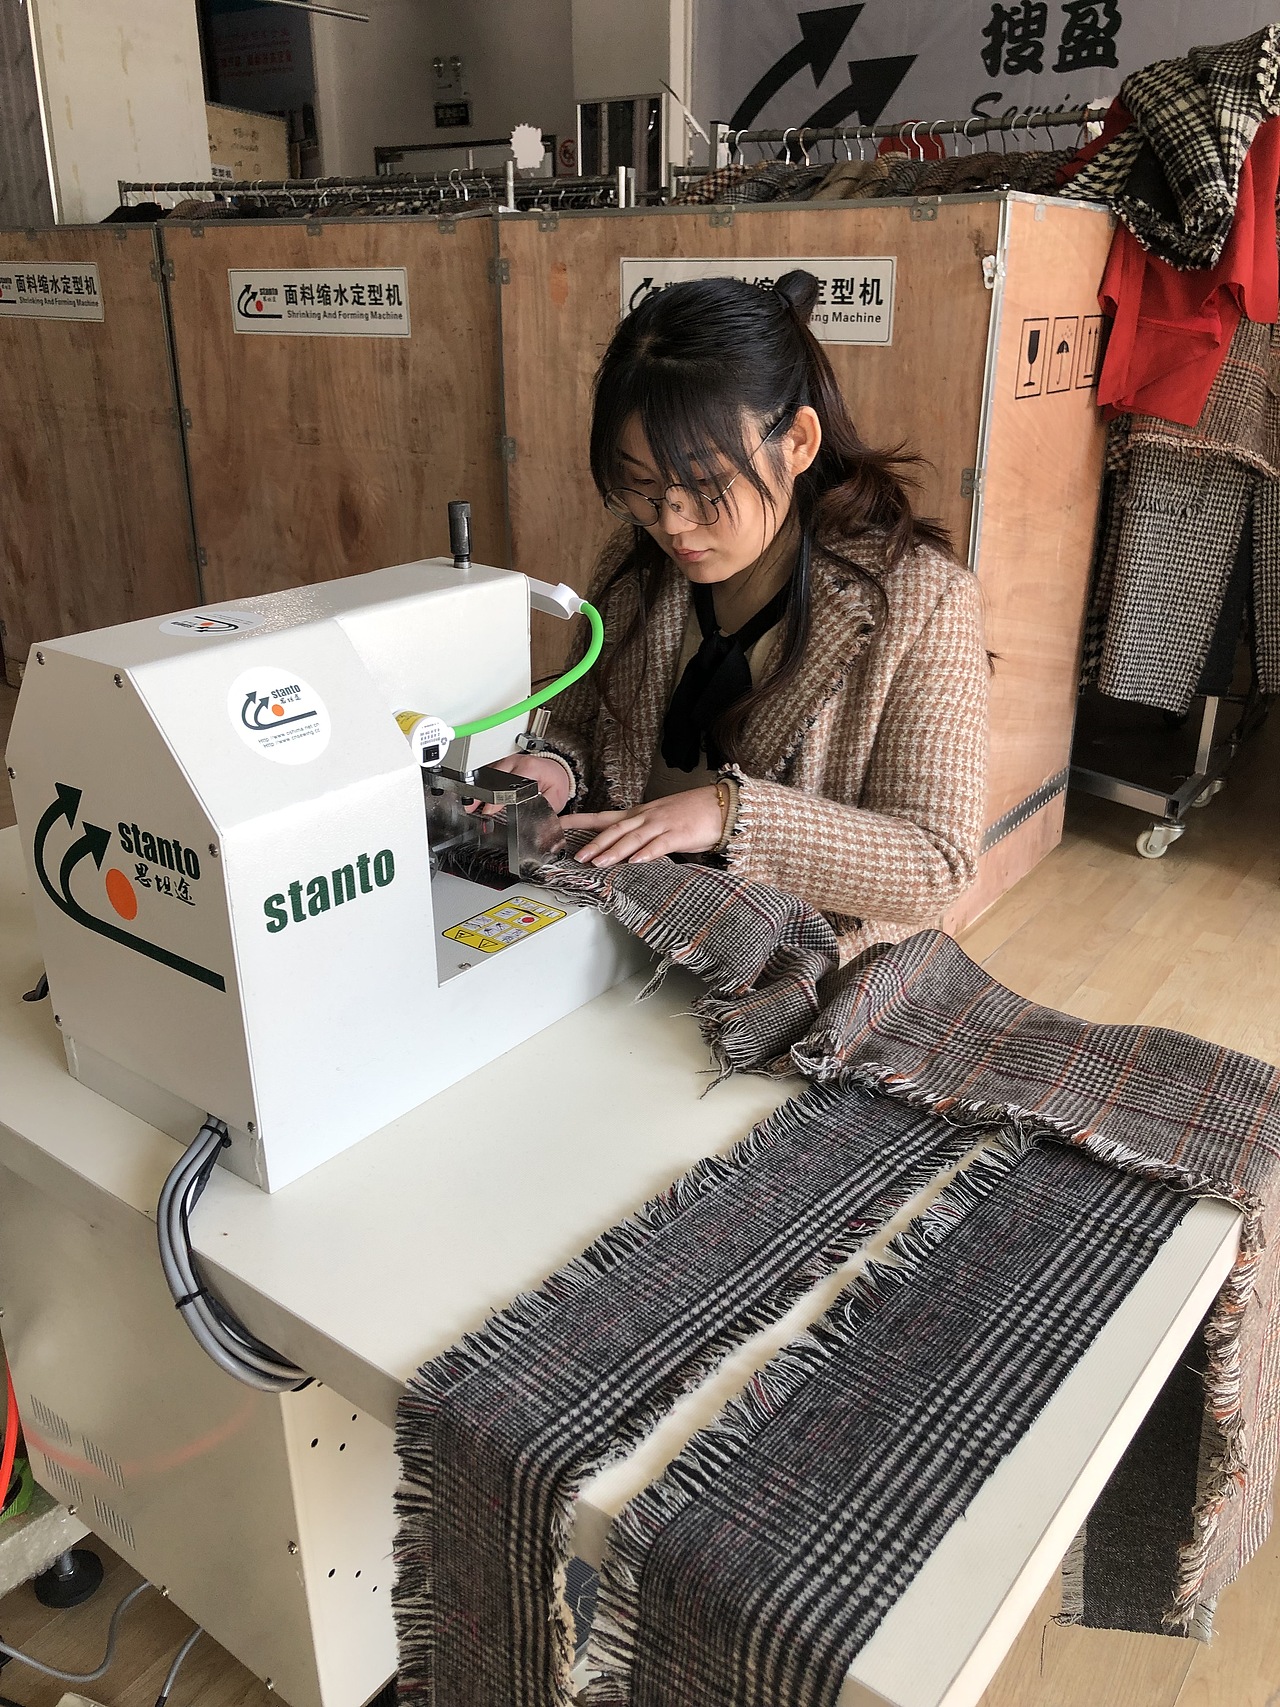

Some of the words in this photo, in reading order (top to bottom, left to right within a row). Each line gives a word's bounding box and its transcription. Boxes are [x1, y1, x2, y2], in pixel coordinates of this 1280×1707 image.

[980, 0, 1122, 77] 搜盈
[14, 274, 97, 295] 面料缩水定型机
[283, 283, 403, 306] 面料缩水定型机
[287, 310, 321, 321] Shrinking
[322, 310, 337, 319] And
[338, 310, 369, 321] Forming
[370, 311, 403, 320] Machine
[831, 311, 882, 323] Machine
[271, 684, 301, 699] stanto
[118, 821, 201, 881] stanto
[263, 849, 395, 933] stanto
